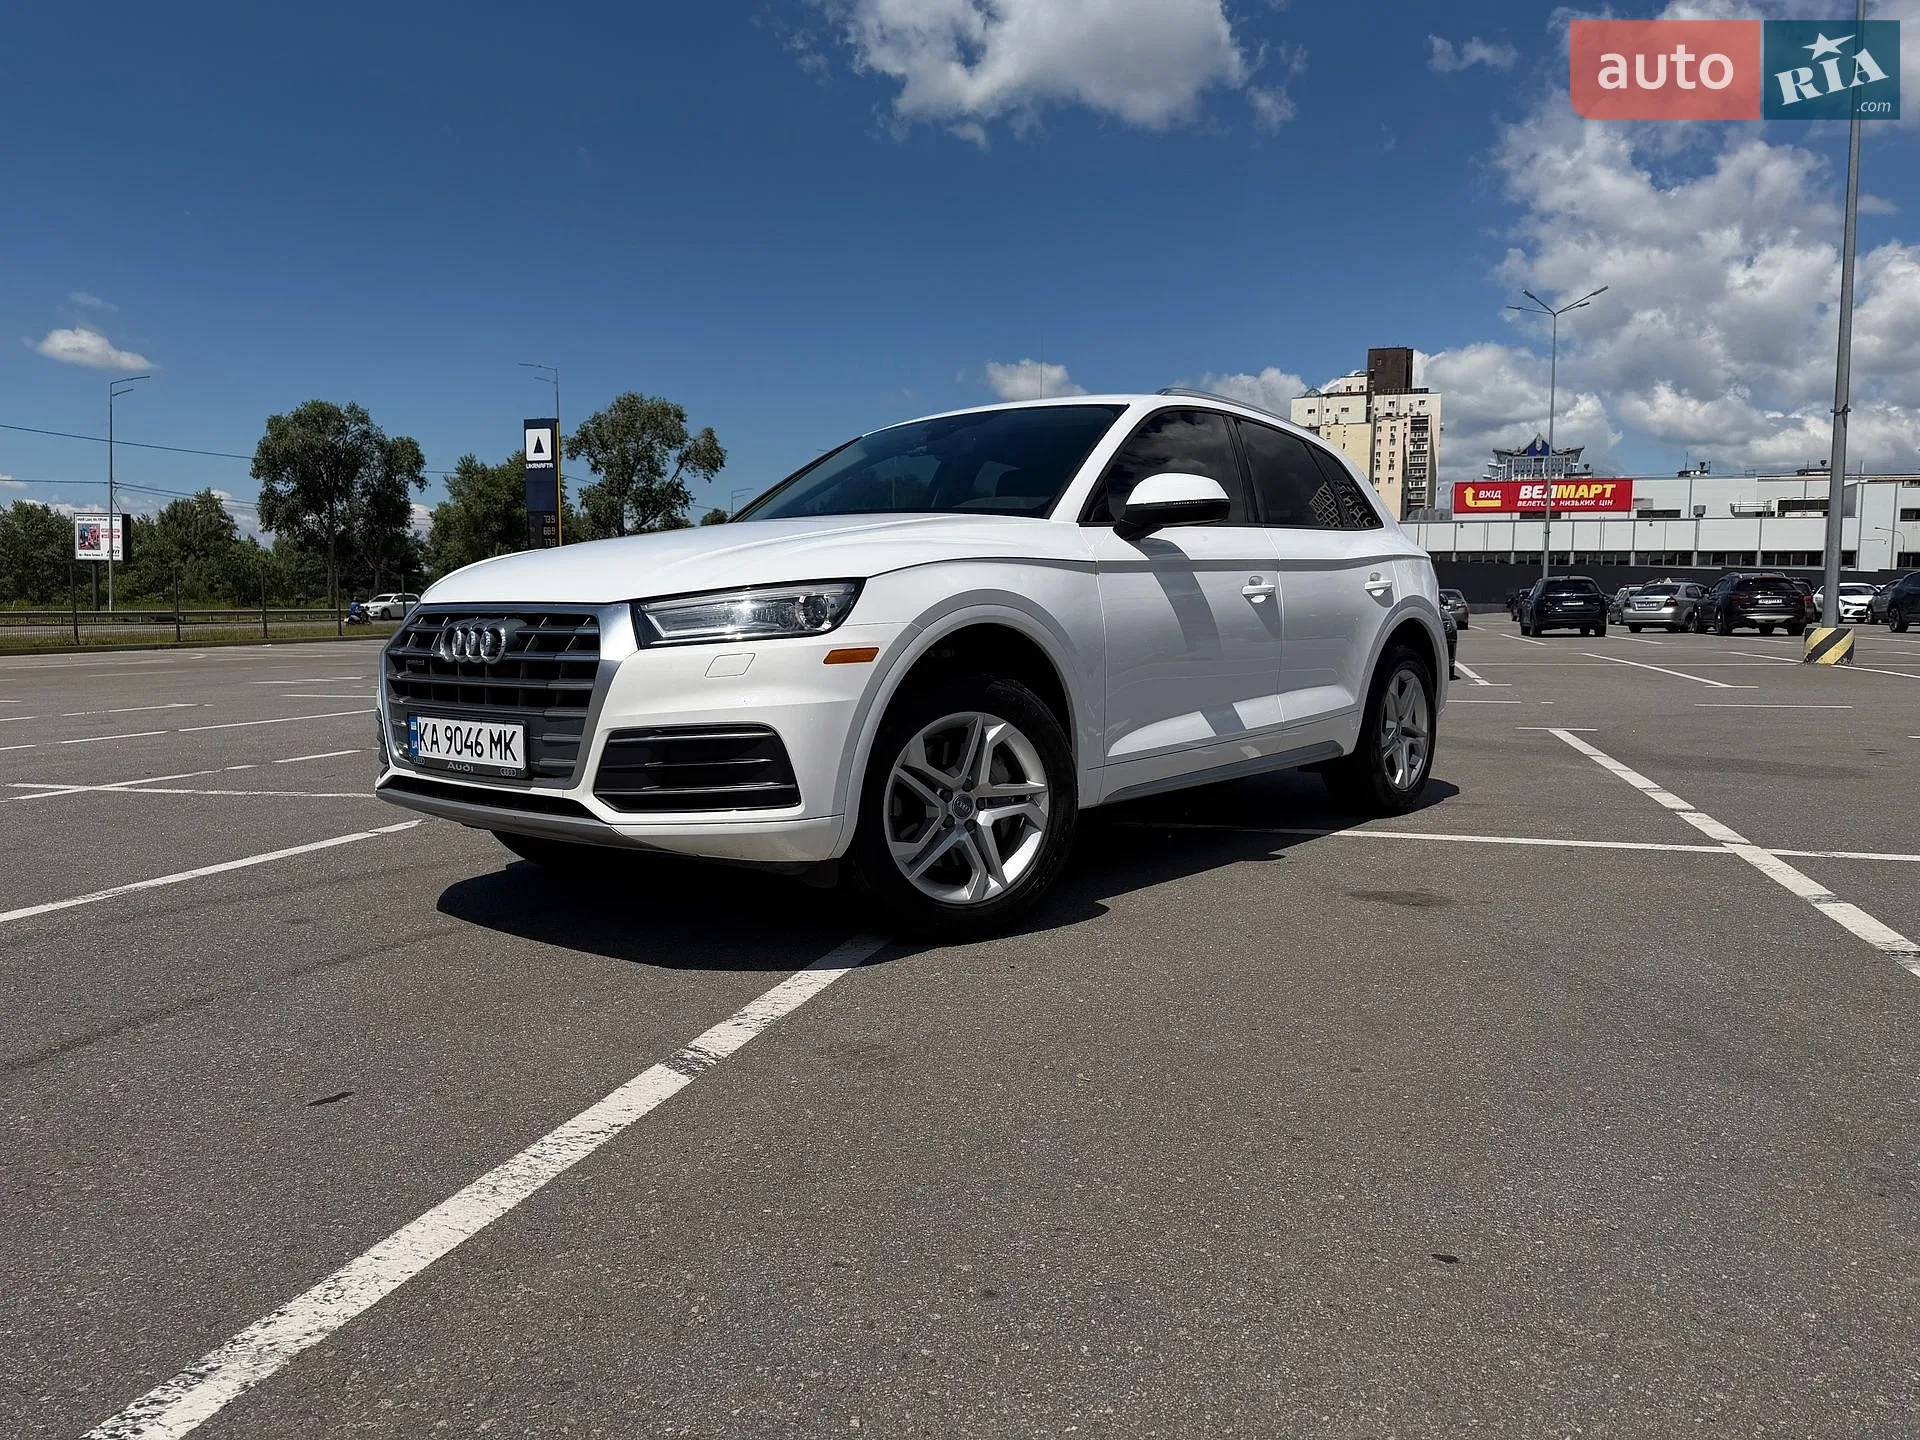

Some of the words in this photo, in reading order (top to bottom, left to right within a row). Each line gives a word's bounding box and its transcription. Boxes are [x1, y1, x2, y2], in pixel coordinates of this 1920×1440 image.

[1478, 489, 1501, 499] ВХІД
[1559, 499, 1596, 507] НИЗЬКИХ
[1598, 499, 1614, 507] ЦІН
[418, 721, 441, 754] KA
[444, 725, 485, 758] 9046
[488, 728, 518, 761] MK
[447, 762, 474, 773] Audi
